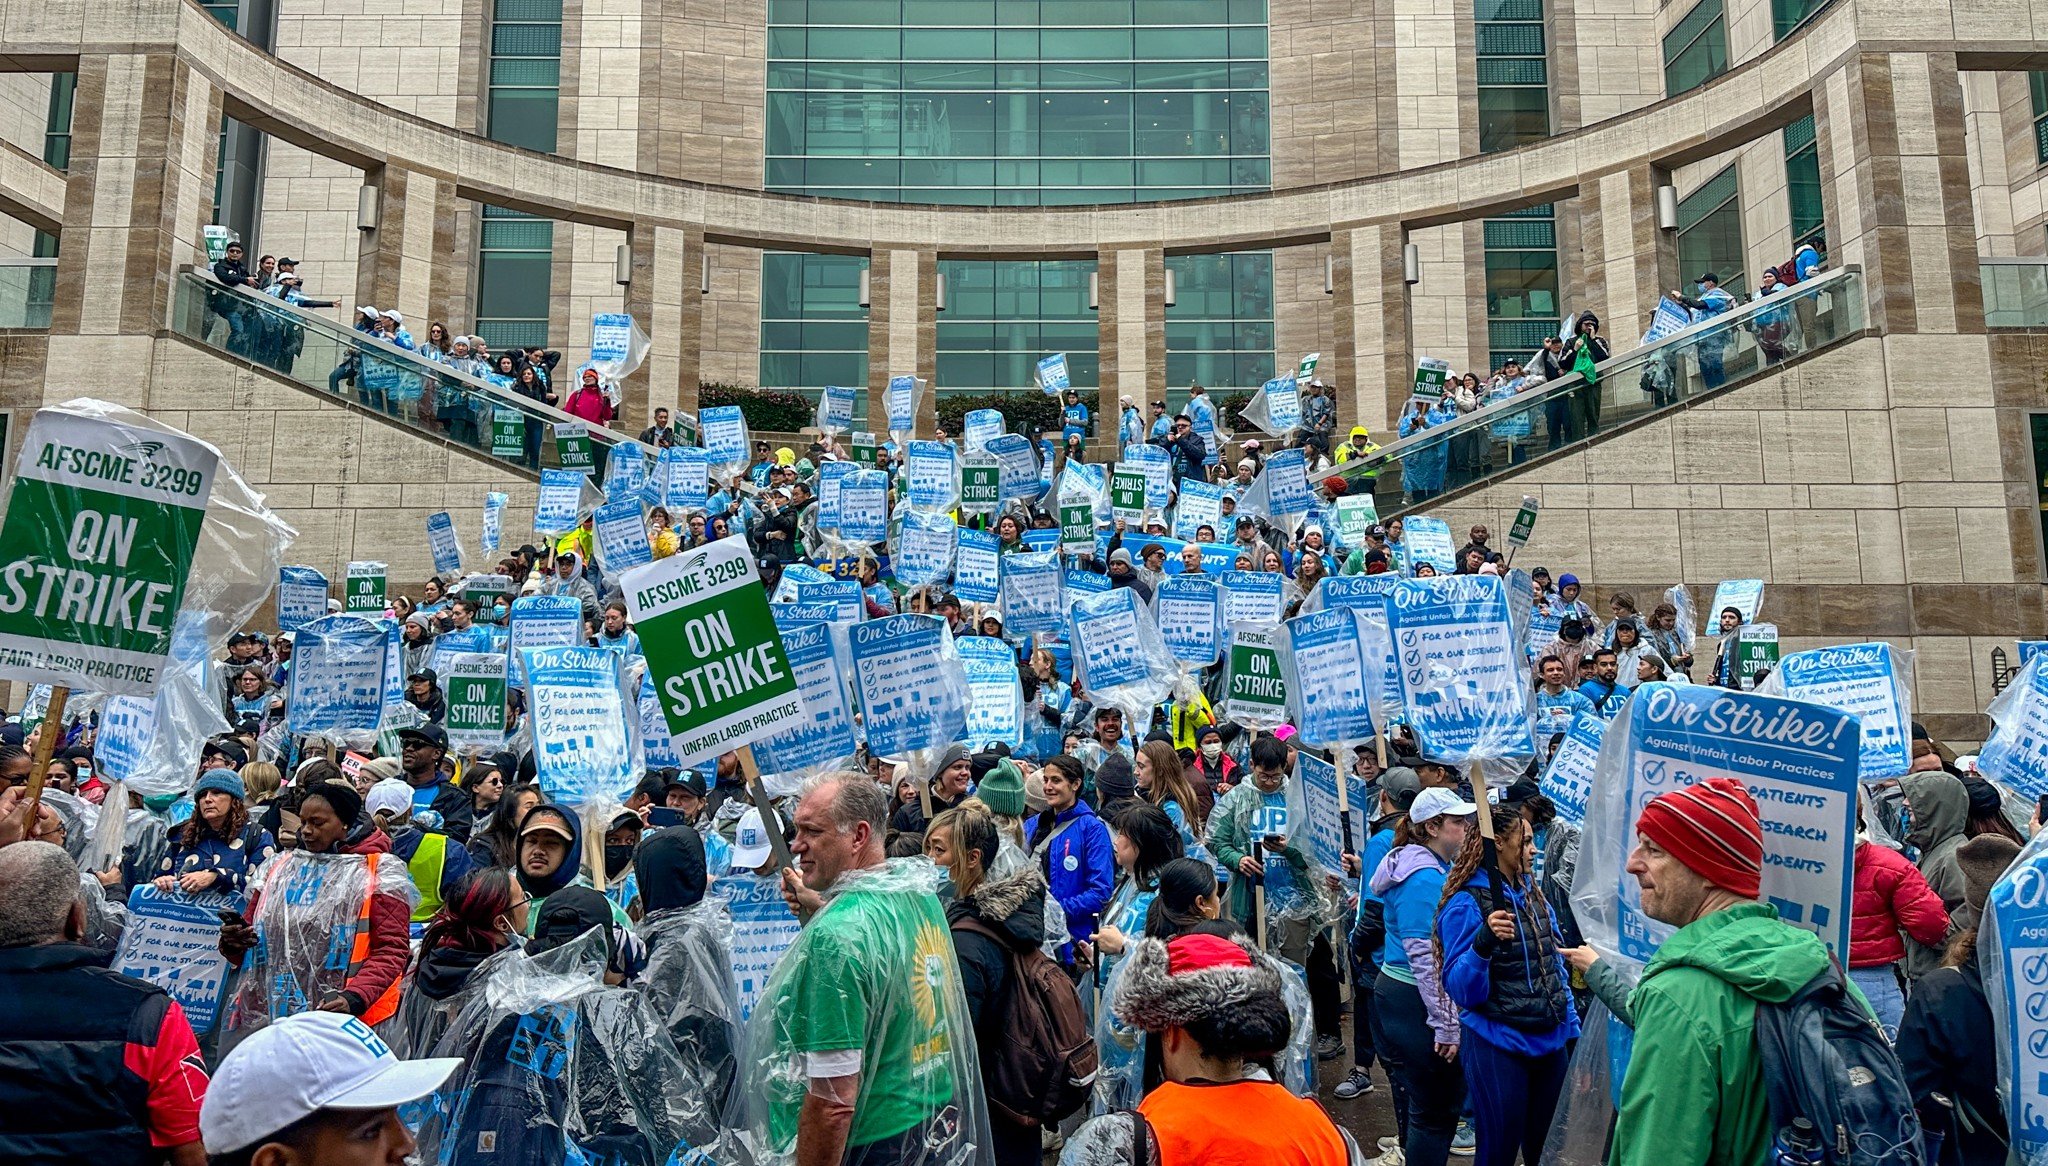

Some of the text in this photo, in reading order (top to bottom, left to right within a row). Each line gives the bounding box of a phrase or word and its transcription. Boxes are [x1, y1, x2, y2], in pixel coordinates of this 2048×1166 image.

[1425, 372, 1437, 383] ON
[1415, 381, 1443, 394] STRIKE
[703, 410, 715, 418] On
[503, 425, 514, 435] ON
[679, 428, 688, 437] ON
[495, 436, 521, 446] STRIKE
[567, 441, 579, 452] ON
[561, 452, 590, 464] STRIKE
[861, 450, 870, 460] ON
[36, 443, 203, 497] AFSCME 3299
[974, 472, 987, 485] ON
[1114, 477, 1144, 491] STRIKE
[964, 485, 996, 498] STRIKE
[1121, 491, 1133, 505] ON
[598, 500, 638, 516] On Strike!
[1070, 510, 1082, 524] ON
[1351, 510, 1364, 521] ON
[1522, 514, 1530, 524] ON
[1063, 525, 1091, 539] STRIKE
[1512, 522, 1532, 537] STRIKE
[67, 509, 138, 568] ON
[960, 531, 999, 544] On Strike!
[469, 581, 505, 589] AFSCME 3299
[637, 556, 749, 611] AFSCME 3299
[1068, 571, 1111, 586] On Strike!
[1227, 573, 1279, 584] On Strike!
[359, 581, 373, 594] ON
[802, 583, 857, 597] On Strike!
[1162, 582, 1214, 592] On Strike!
[1328, 580, 1348, 596] On
[0, 560, 173, 634] STRIKE
[478, 594, 493, 607] ON
[1394, 579, 1497, 609] On Strike!
[348, 594, 383, 608] STRIKE
[516, 598, 576, 611] On Strike!
[786, 605, 834, 620] Strike!
[1399, 614, 1428, 624] Against
[1429, 612, 1451, 621] Unfair
[684, 609, 736, 659] ON
[1295, 620, 1312, 636] On
[1422, 627, 1499, 641] FOR OUR PATIENTS
[453, 634, 478, 644] Strike!
[857, 626, 883, 644] On
[1237, 631, 1267, 644] AFSCME
[957, 639, 975, 650] On
[1425, 646, 1504, 660] FOR OUR RESEARCH
[1751, 646, 1765, 658] ON
[1788, 644, 1882, 673] On Strike!
[532, 649, 612, 670] On Strike!
[877, 655, 908, 667] FOR OUR
[1250, 654, 1270, 675] ON
[86, 660, 155, 684] PRACTICE
[454, 663, 503, 674] AFSCME 3299
[795, 662, 826, 676] PATIENTS
[1428, 664, 1507, 679] FOR OUR STUDENTS
[1742, 660, 1776, 674] STRIKE
[664, 640, 784, 717] STRIKE
[880, 669, 909, 681] FOR OUR
[467, 683, 486, 702] ON
[882, 686, 897, 695] FOR
[1233, 674, 1284, 699] STRIKE
[1809, 681, 1882, 696] FOR OUR PATIENTS
[1847, 694, 1885, 705] RESEARCH
[451, 704, 500, 724] STRIKE
[1247, 706, 1261, 714] LABOR
[2028, 710, 2041, 722] FOR
[1647, 686, 1850, 750] On Strike!
[556, 724, 571, 732] FOR
[682, 701, 799, 756] UNFAIR LABOR PRACTICE
[1577, 716, 1598, 735] On
[1428, 728, 1476, 739] University
[1578, 747, 1591, 758] FOR
[1644, 735, 1836, 781] Against Unfair Labor Practices
[1304, 756, 1321, 773] On
[1572, 757, 1586, 768] FOR
[1566, 767, 1581, 778] FOR
[1748, 785, 1827, 809] PATIENTS
[136, 906, 162, 914] Against
[182, 912, 201, 920] Labor
[150, 922, 219, 936] FOR OUR PATIENT
[753, 926, 769, 934] OUR
[145, 938, 179, 948] FOR OUR
[734, 945, 767, 954] FOR OUR
[141, 952, 177, 963] FOR OUR
[733, 963, 767, 972] FOR OUR
[182, 1005, 213, 1014] ssional
